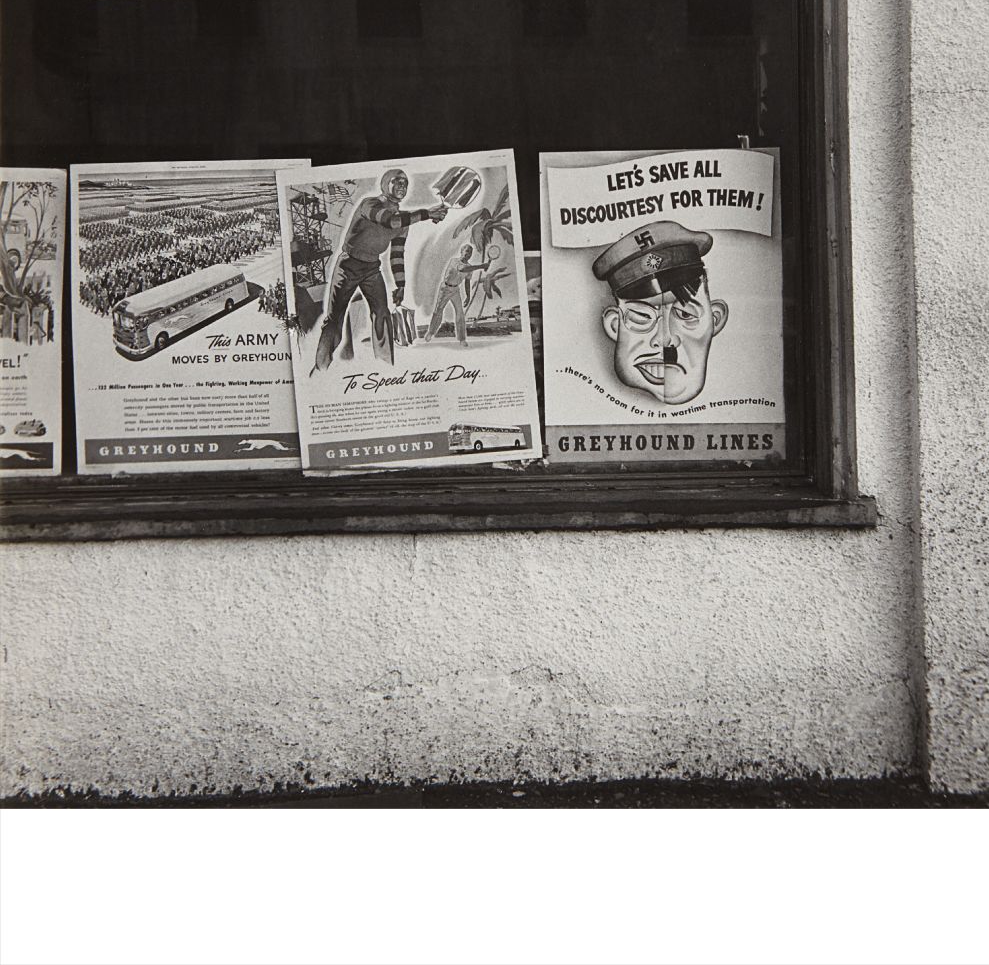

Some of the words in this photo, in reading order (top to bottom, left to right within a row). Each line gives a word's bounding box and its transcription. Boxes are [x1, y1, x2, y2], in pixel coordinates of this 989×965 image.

[606, 164, 645, 192] LET'S
[649, 161, 689, 184] SAVE
[693, 160, 722, 178] ALL
[560, 194, 665, 226] DISCOURTESY
[670, 189, 703, 210] FOR
[205, 334, 232, 350] This
[235, 333, 279, 346] ARMY
[172, 354, 209, 364] MOVES
[214, 354, 228, 363] BY
[232, 352, 293, 363] GREYHOUN
[343, 374, 364, 394] To
[362, 370, 407, 393] Speed
[410, 367, 444, 384] that
[594, 382, 606, 395] no
[606, 392, 629, 410] room
[630, 405, 645, 416] for
[648, 409, 655, 419] it
[658, 410, 667, 419] in
[671, 403, 707, 418] wartime
[709, 397, 776, 408] transportation
[99, 442, 220, 457] GREYHOUND
[326, 440, 435, 459] GREYHOUND
[558, 434, 695, 452] GREYHOUND
[707, 434, 774, 451] LINES
